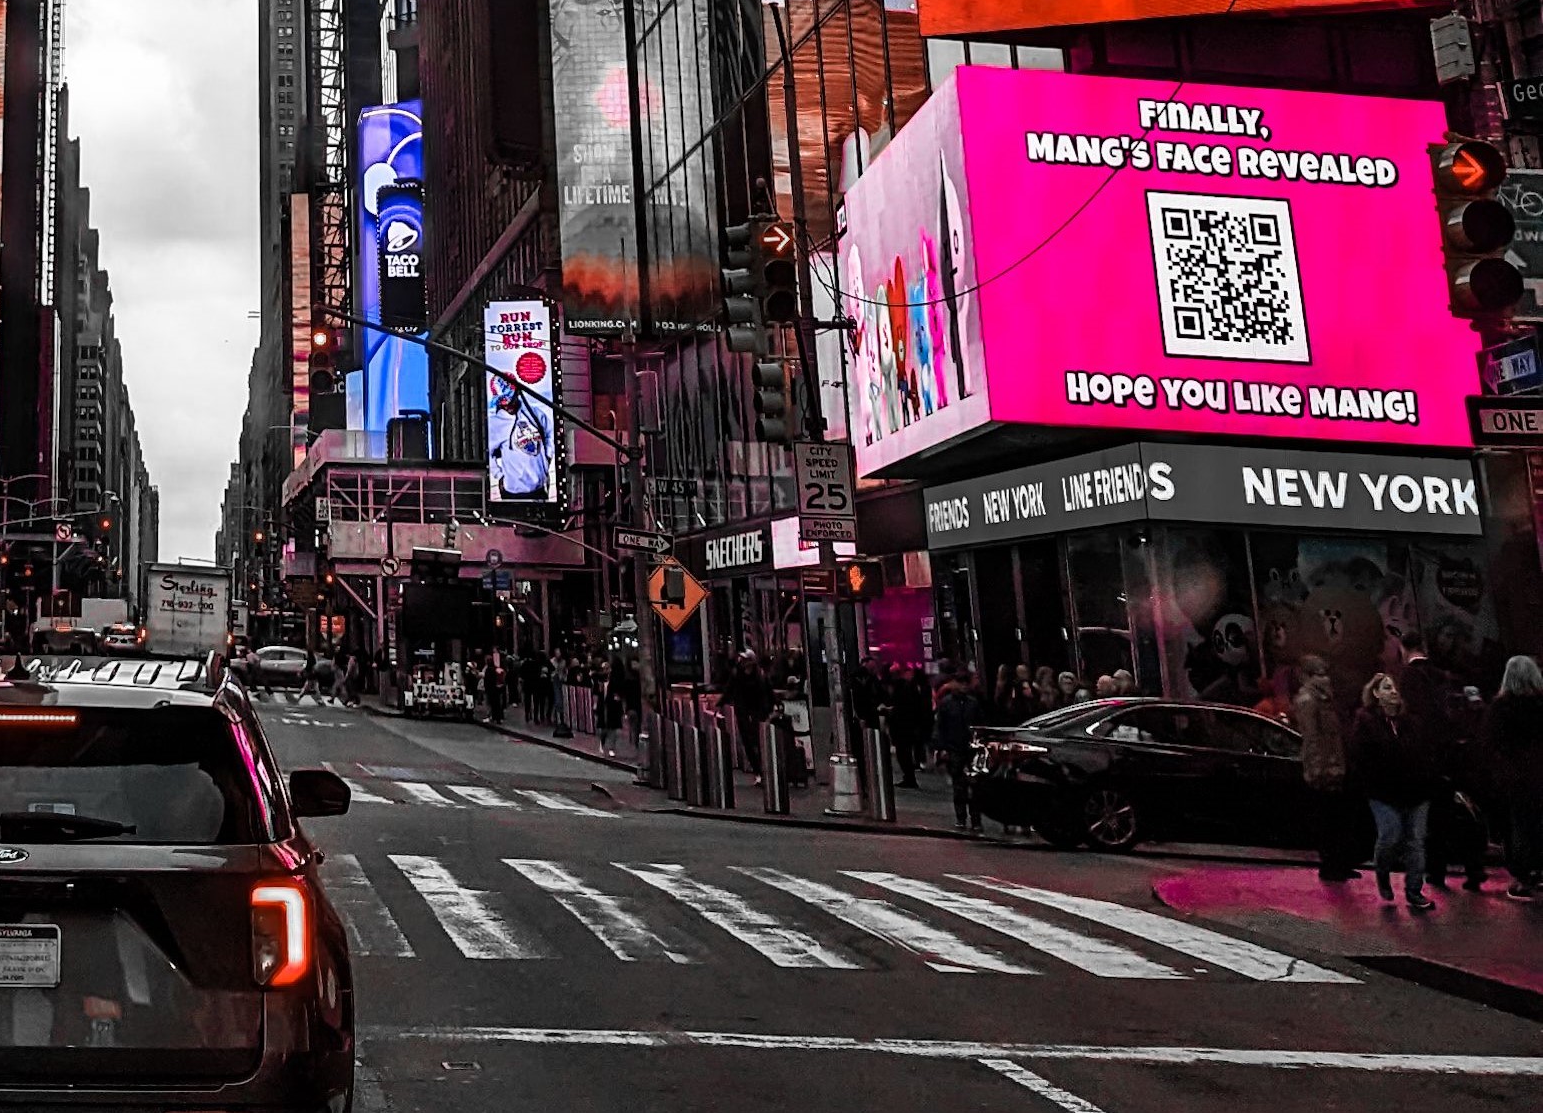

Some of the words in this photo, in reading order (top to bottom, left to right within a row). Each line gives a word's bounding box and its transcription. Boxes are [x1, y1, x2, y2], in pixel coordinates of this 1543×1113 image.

[563, 184, 631, 206] LIFETIME
[384, 254, 420, 266] TACO
[387, 266, 420, 278] BELL
[500, 311, 531, 324] RUN
[489, 321, 543, 334] FORREST
[502, 331, 533, 344] RUN
[1511, 354, 1532, 377] WAY
[1309, 387, 1419, 425] MANG!
[1492, 412, 1539, 431] ONE
[809, 446, 833, 457] CITY
[805, 458, 839, 469] SPEED
[809, 470, 836, 480] LIMIT
[657, 480, 668, 493] W
[671, 481, 685, 494] 45
[804, 483, 848, 511] 25
[928, 496, 970, 534] FRIENDS
[983, 488, 1010, 525] NEW
[1011, 481, 1047, 519] YORK
[1062, 471, 1094, 512] LINE
[1241, 466, 1349, 510] NEW
[1358, 472, 1482, 517] YORK
[813, 520, 843, 530] PHOTO
[805, 529, 852, 539] ENFORCED
[622, 534, 642, 546] ONE
[647, 537, 666, 549] WAY
[705, 529, 763, 571] SKECHERS
[160, 574, 216, 598] Sterling
